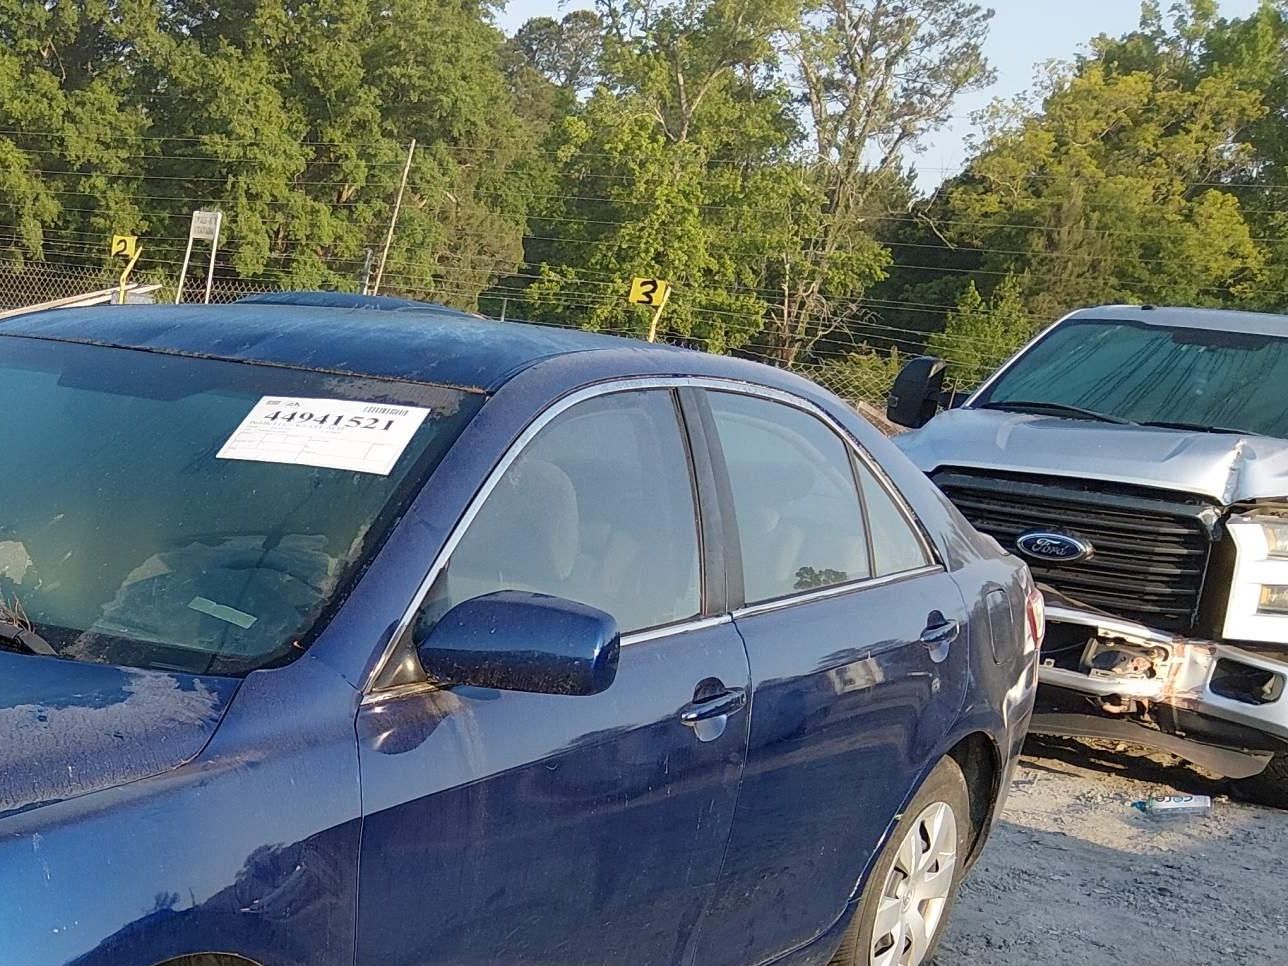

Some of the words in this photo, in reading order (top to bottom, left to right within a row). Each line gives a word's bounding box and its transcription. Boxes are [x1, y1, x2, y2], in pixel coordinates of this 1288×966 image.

[113, 239, 129, 257] 2
[637, 280, 658, 304] 3
[264, 410, 395, 431] 44941521
[1032, 538, 1068, 556] Ford
